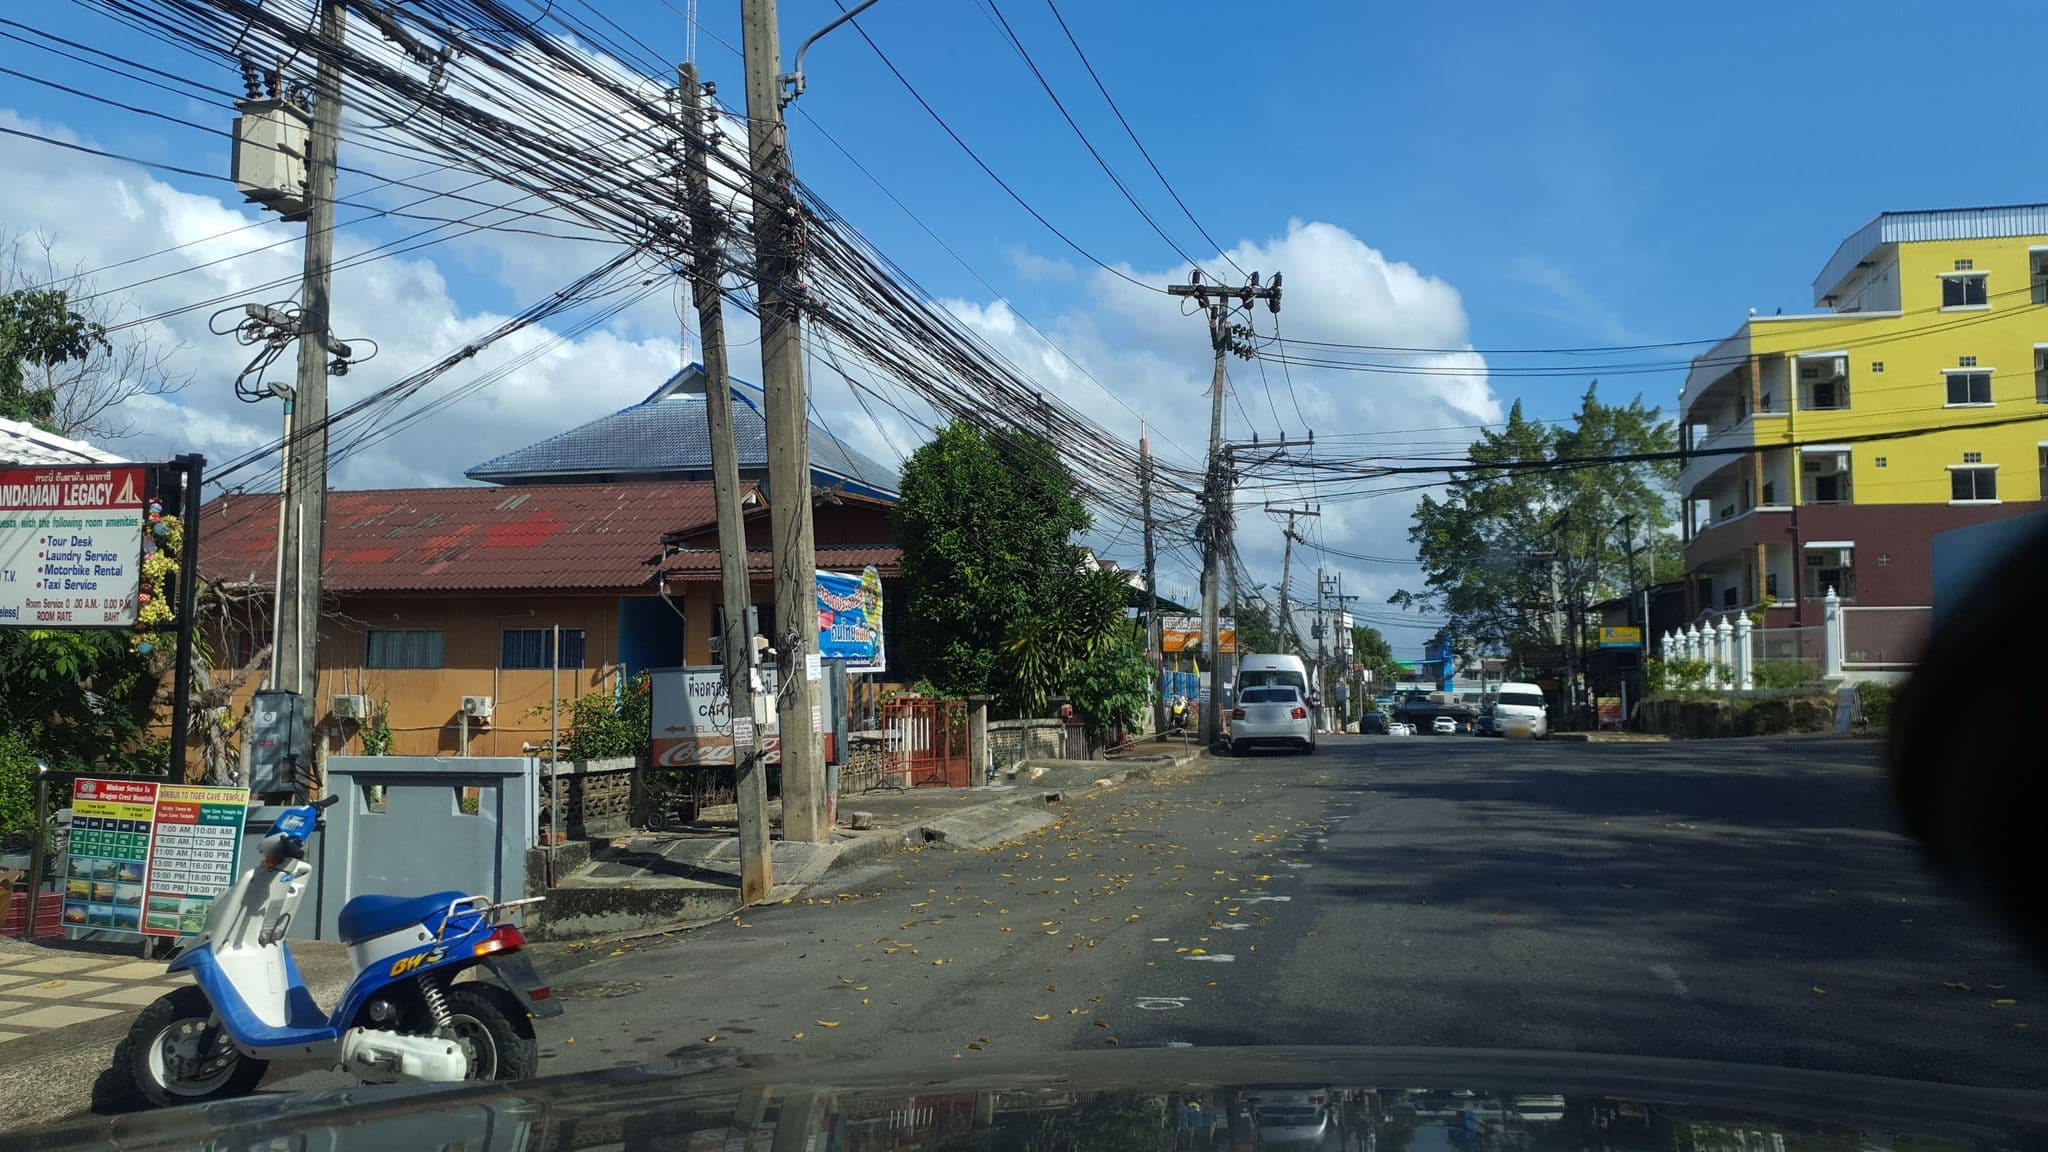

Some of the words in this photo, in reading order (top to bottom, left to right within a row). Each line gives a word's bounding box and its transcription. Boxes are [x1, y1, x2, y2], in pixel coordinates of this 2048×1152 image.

[64, 483, 114, 506] LEGACY
[21, 517, 36, 528] with
[39, 517, 50, 528] the
[53, 517, 82, 530] following
[85, 519, 103, 528] room
[106, 516, 138, 527] amenities
[48, 536, 67, 546] Tour
[71, 536, 93, 547] Desk
[46, 550, 81, 564] Laundry
[85, 550, 118, 561] Service
[45, 564, 90, 575] Motorbike
[94, 565, 123, 576] Rental
[44, 579, 61, 589] Taxi
[64, 579, 97, 590] Service
[26, 598, 41, 608] Room
[43, 598, 64, 608] Service
[37, 611, 55, 621] ROOM
[57, 611, 72, 621] RATE
[104, 612, 120, 621] BAHT
[191, 792, 206, 800] TIGER
[207, 792, 220, 800] CAVE
